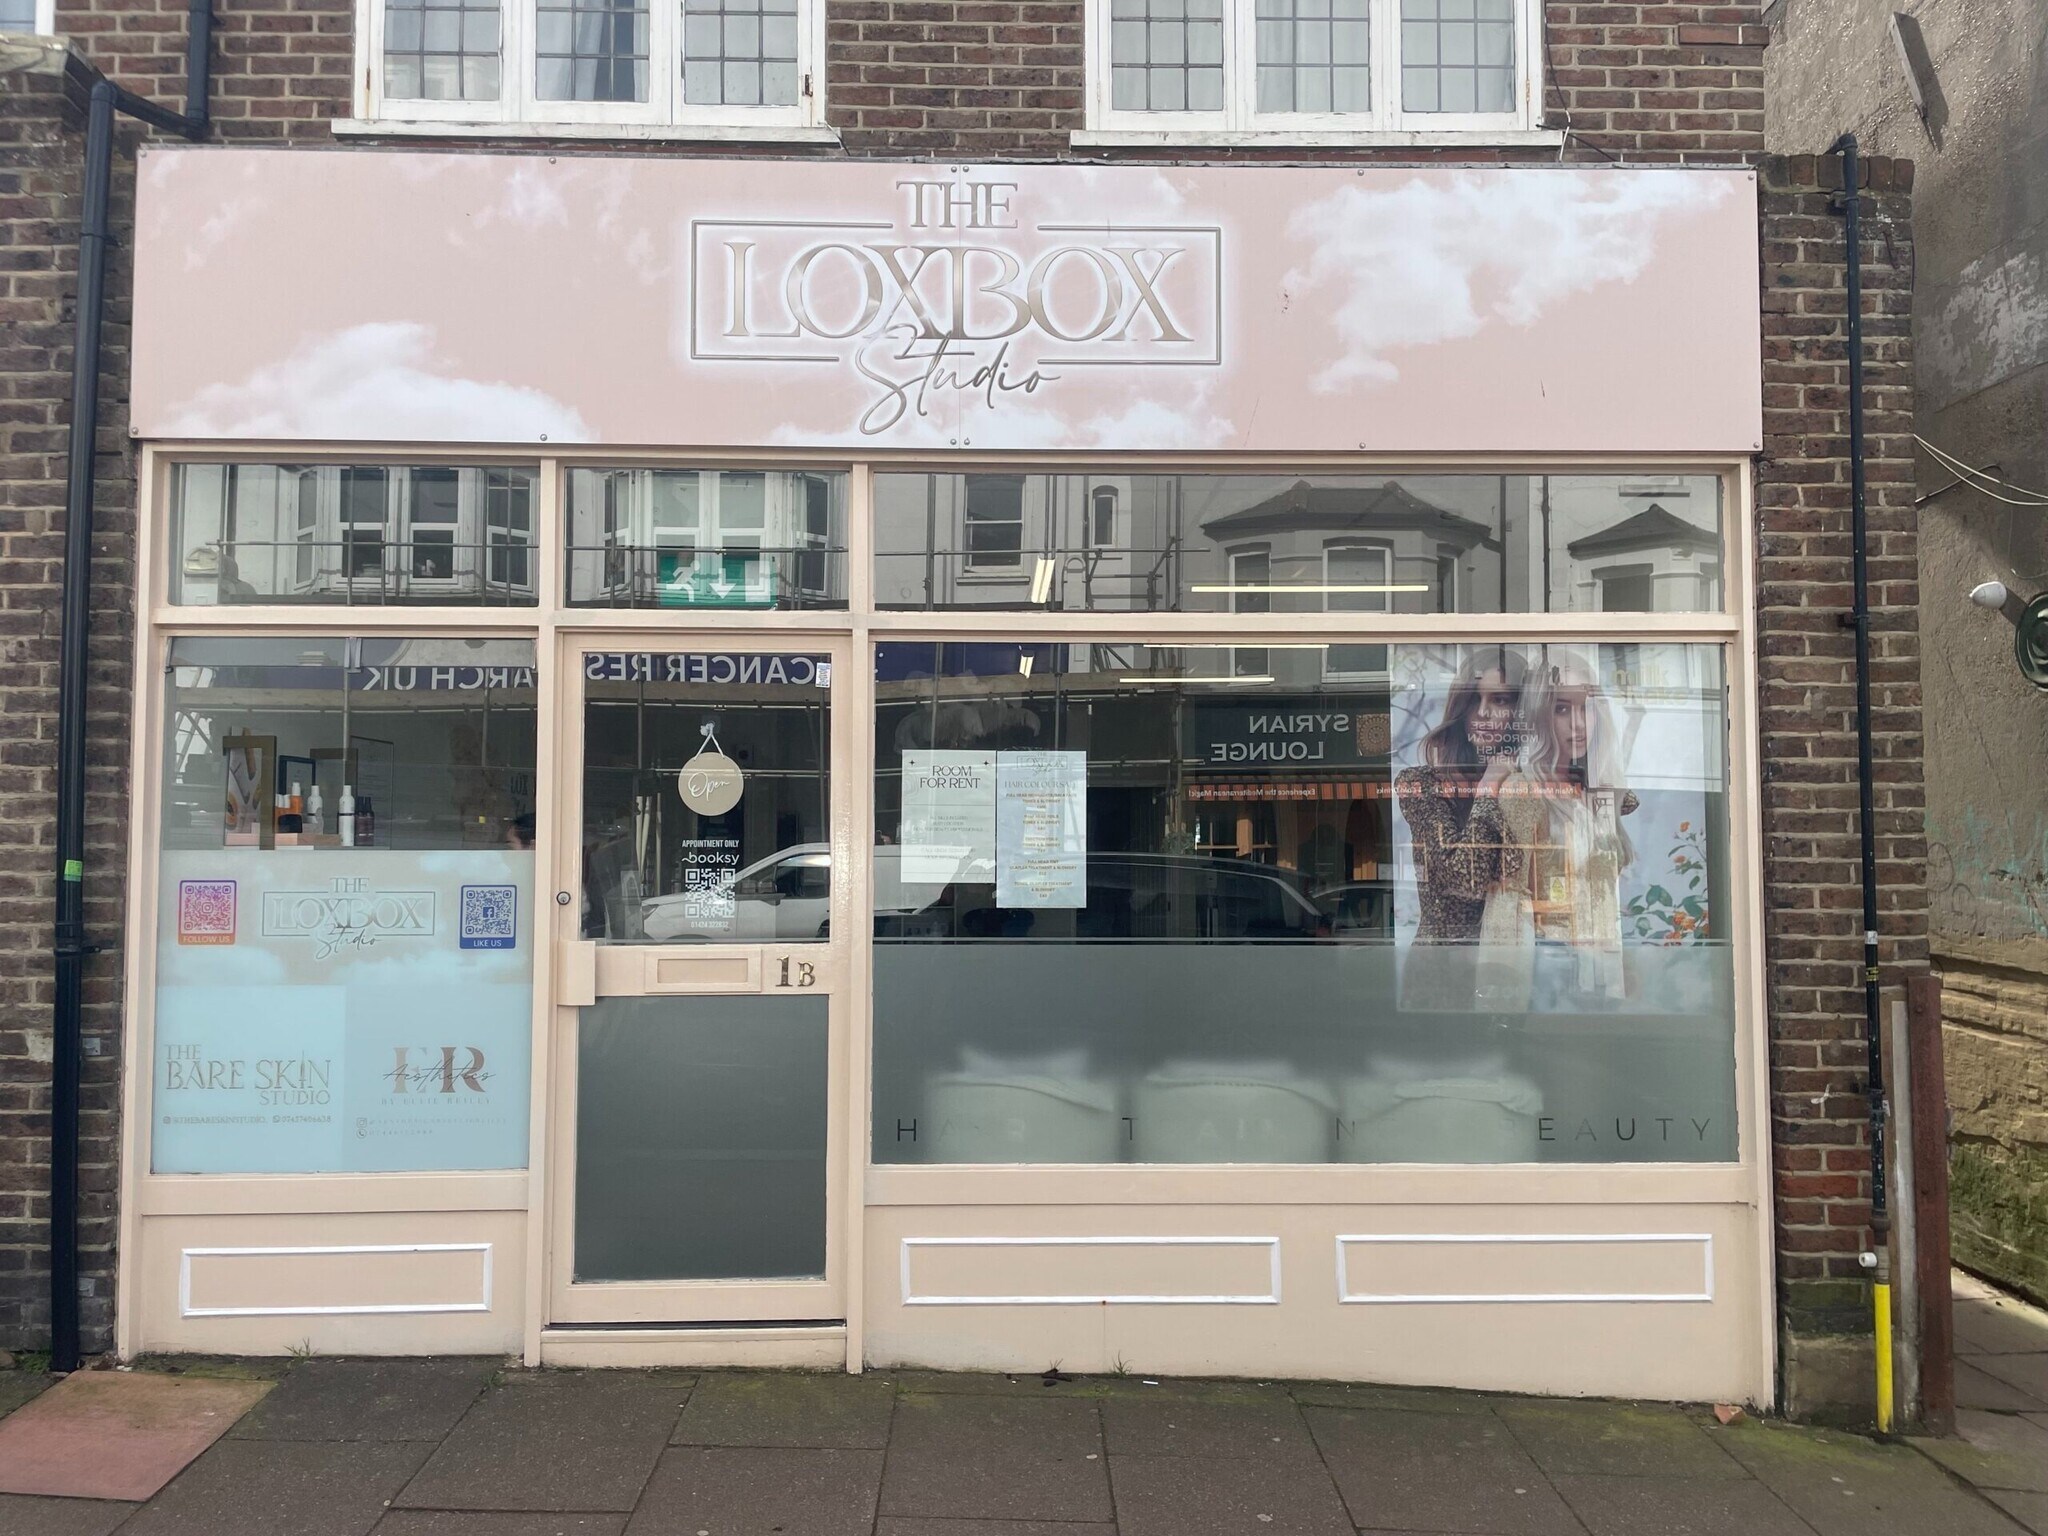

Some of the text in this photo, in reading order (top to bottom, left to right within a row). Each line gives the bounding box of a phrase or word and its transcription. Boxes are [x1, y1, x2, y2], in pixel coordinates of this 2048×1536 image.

[895, 180, 1018, 229] THE
[722, 241, 1195, 342] LOXBOX
[855, 324, 1061, 435] Studio
[932, 765, 972, 776] ROOM
[688, 772, 730, 801] Open
[919, 777, 981, 789] FOR RENT
[682, 839, 740, 848] APPOINTMENT ONLY
[682, 851, 740, 865] booksy
[330, 877, 370, 893] THE
[273, 898, 425, 930] LOXBOX
[183, 935, 231, 943] FOLLOW US
[315, 922, 383, 960] Studio
[473, 939, 502, 947] LIKE US
[164, 1044, 201, 1060] THE
[166, 1050, 331, 1090] BARE SKIN
[259, 1090, 331, 1106] STUDIO
